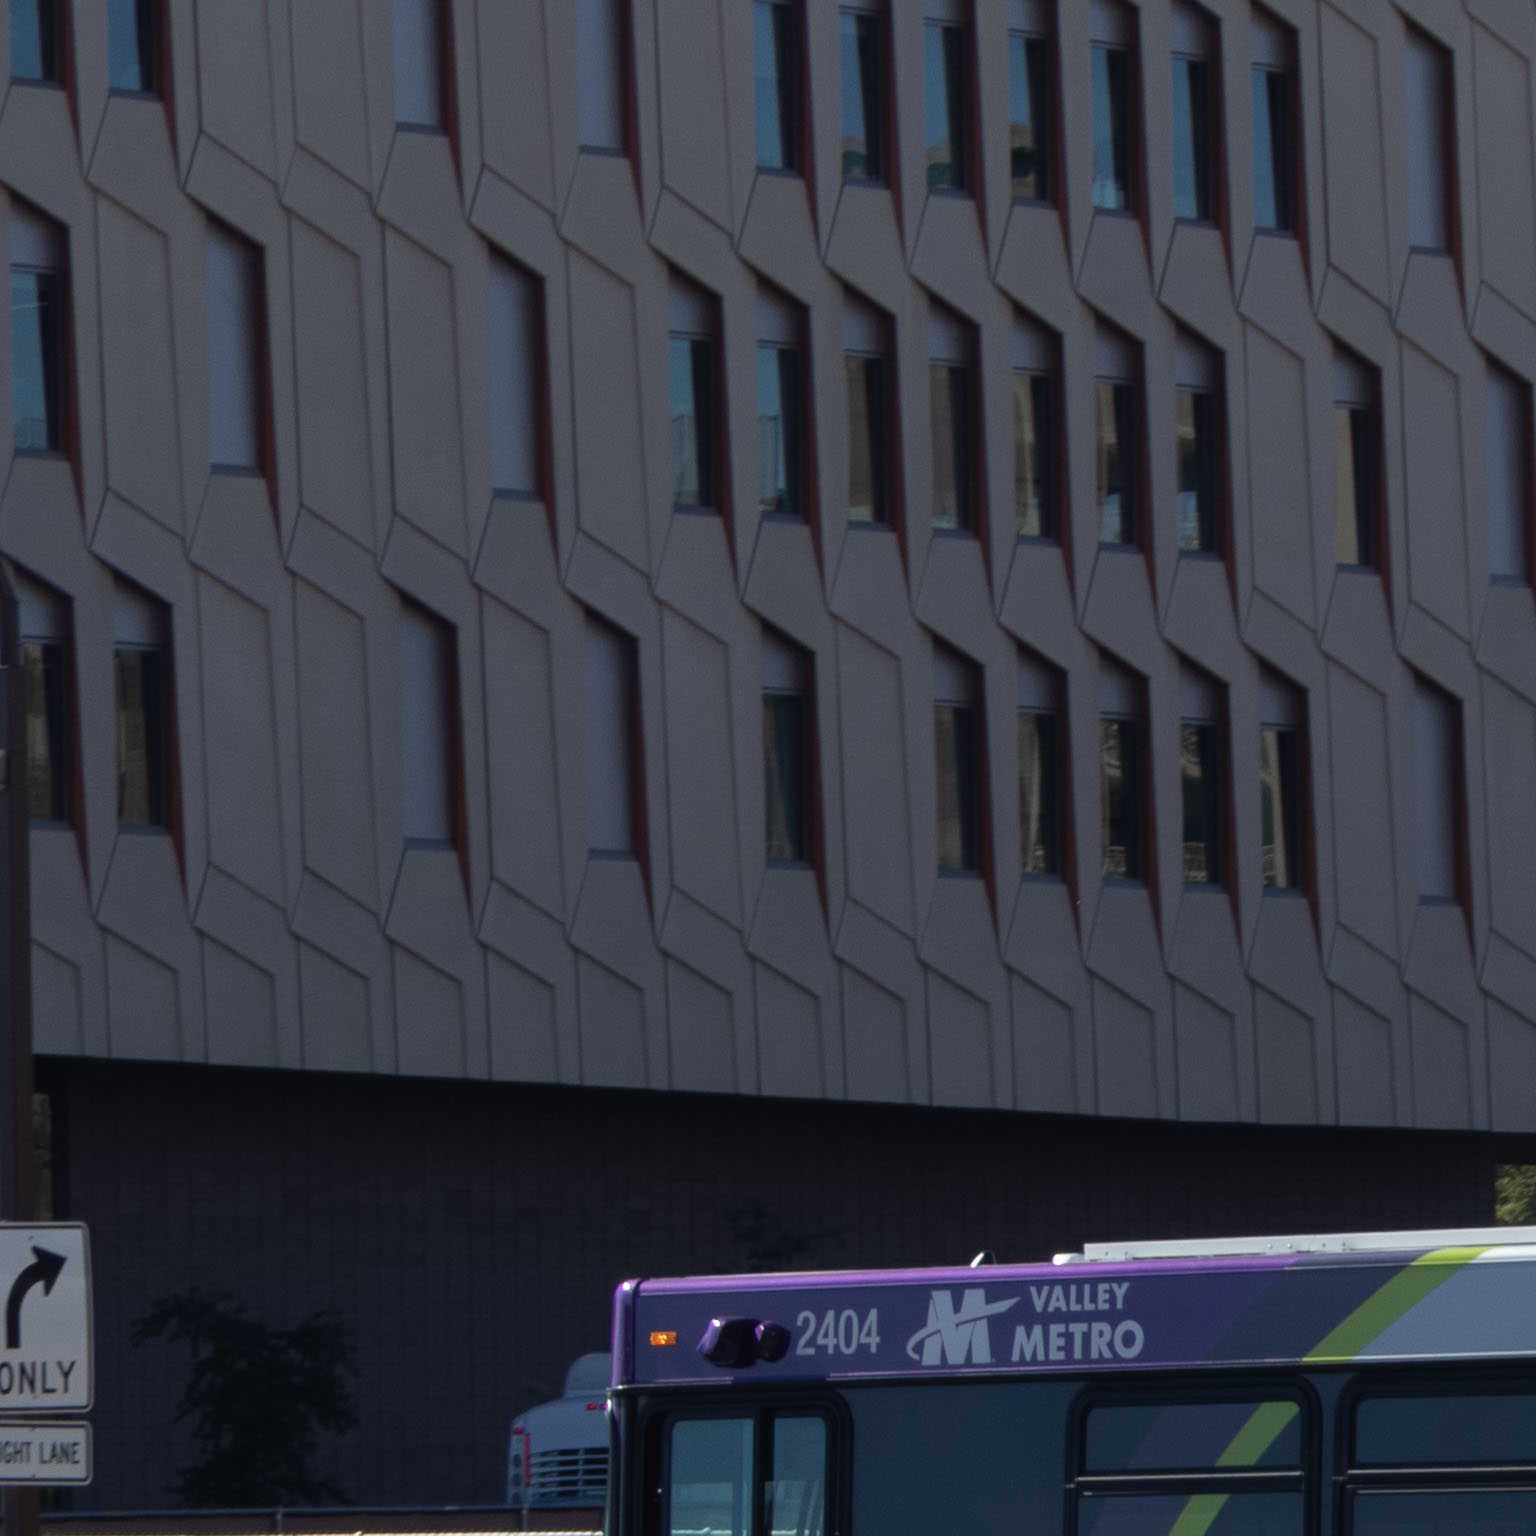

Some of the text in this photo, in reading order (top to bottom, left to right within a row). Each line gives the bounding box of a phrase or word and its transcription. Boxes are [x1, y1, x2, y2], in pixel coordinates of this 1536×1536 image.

[1030, 1282, 1130, 1313] VALLEY
[795, 1308, 880, 1356] 2404
[1011, 1320, 1145, 1362] METRO
[0, 1360, 76, 1395] ONLY
[0, 1441, 80, 1465] IGHT LANE
